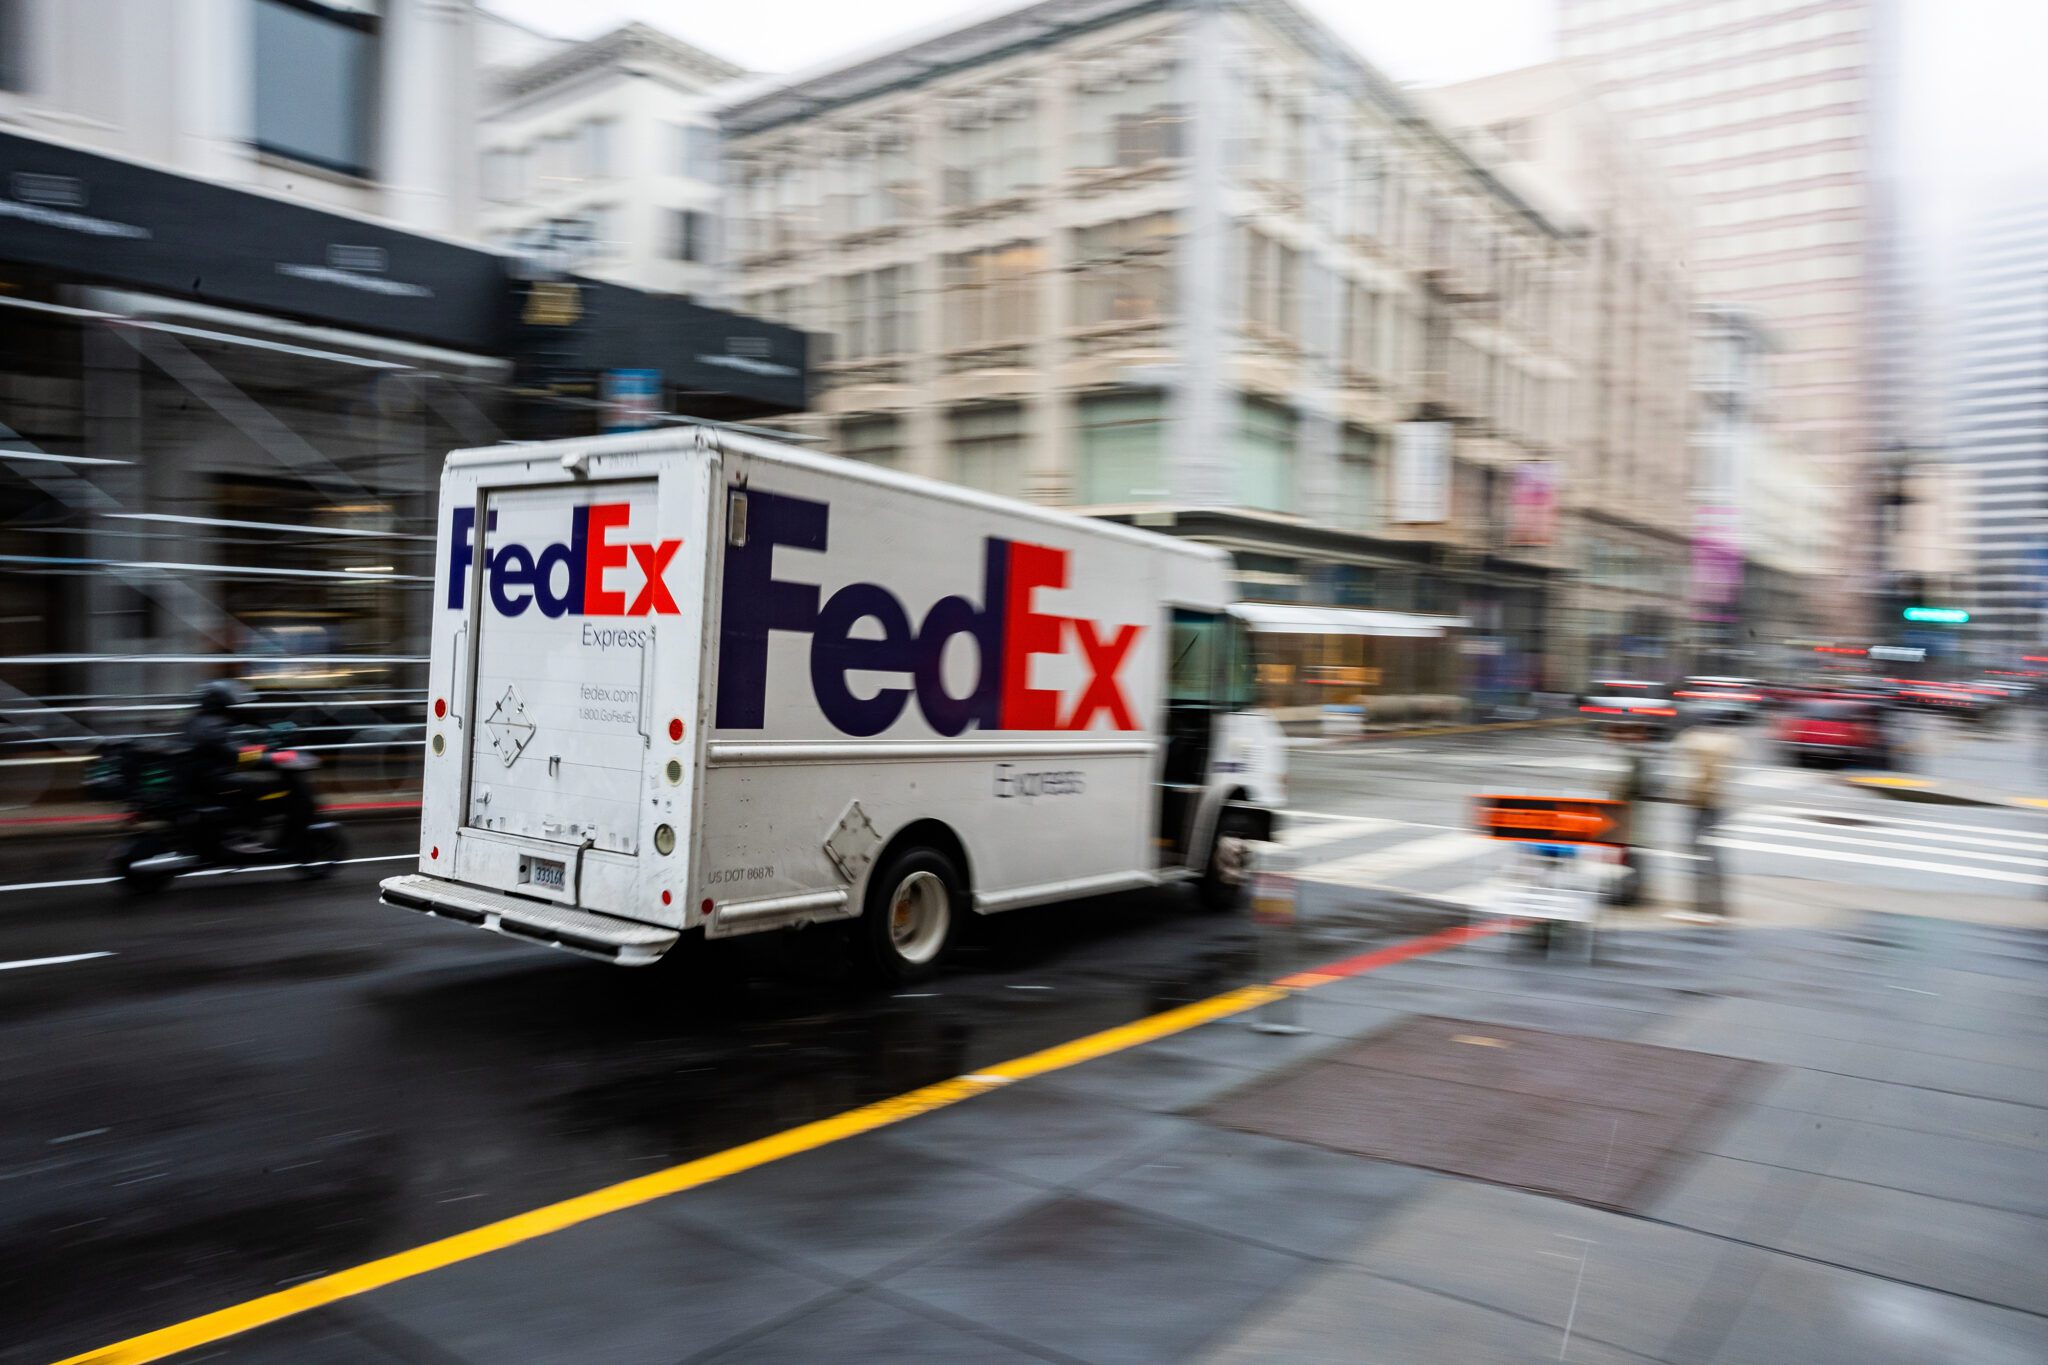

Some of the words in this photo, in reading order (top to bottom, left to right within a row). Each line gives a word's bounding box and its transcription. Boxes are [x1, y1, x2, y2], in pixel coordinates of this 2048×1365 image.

[447, 502, 683, 618] FedEx
[715, 486, 1147, 737] FedEx
[582, 622, 647, 652] Express
[580, 682, 639, 702] fedex.com
[708, 870, 722, 884] US
[724, 868, 745, 883] DOT
